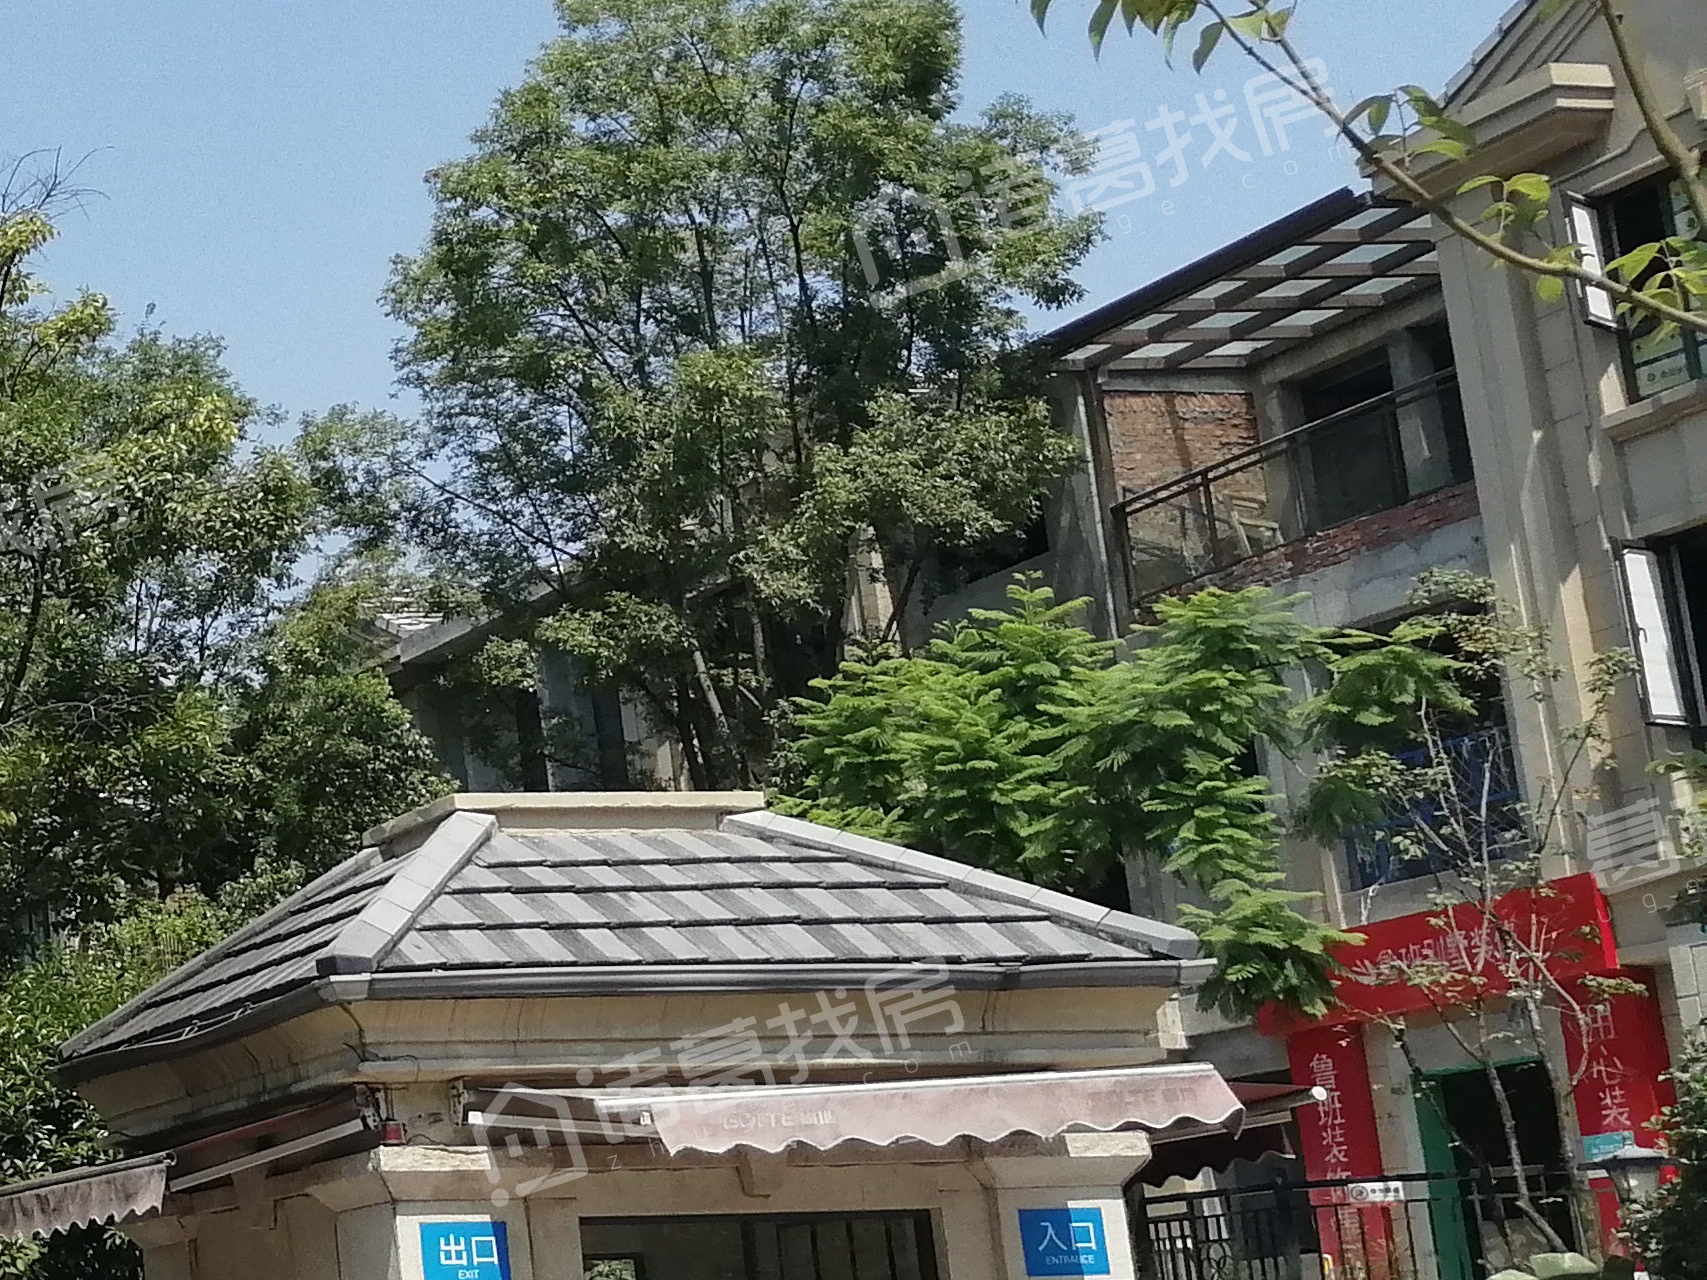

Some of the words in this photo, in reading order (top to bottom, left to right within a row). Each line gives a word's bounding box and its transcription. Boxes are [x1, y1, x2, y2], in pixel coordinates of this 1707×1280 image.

[1038, 1221, 1096, 1251] 入口
[440, 1233, 498, 1266] 出口
[1046, 1254, 1095, 1265] ENTRANCE
[458, 1269, 480, 1280] EXIT
